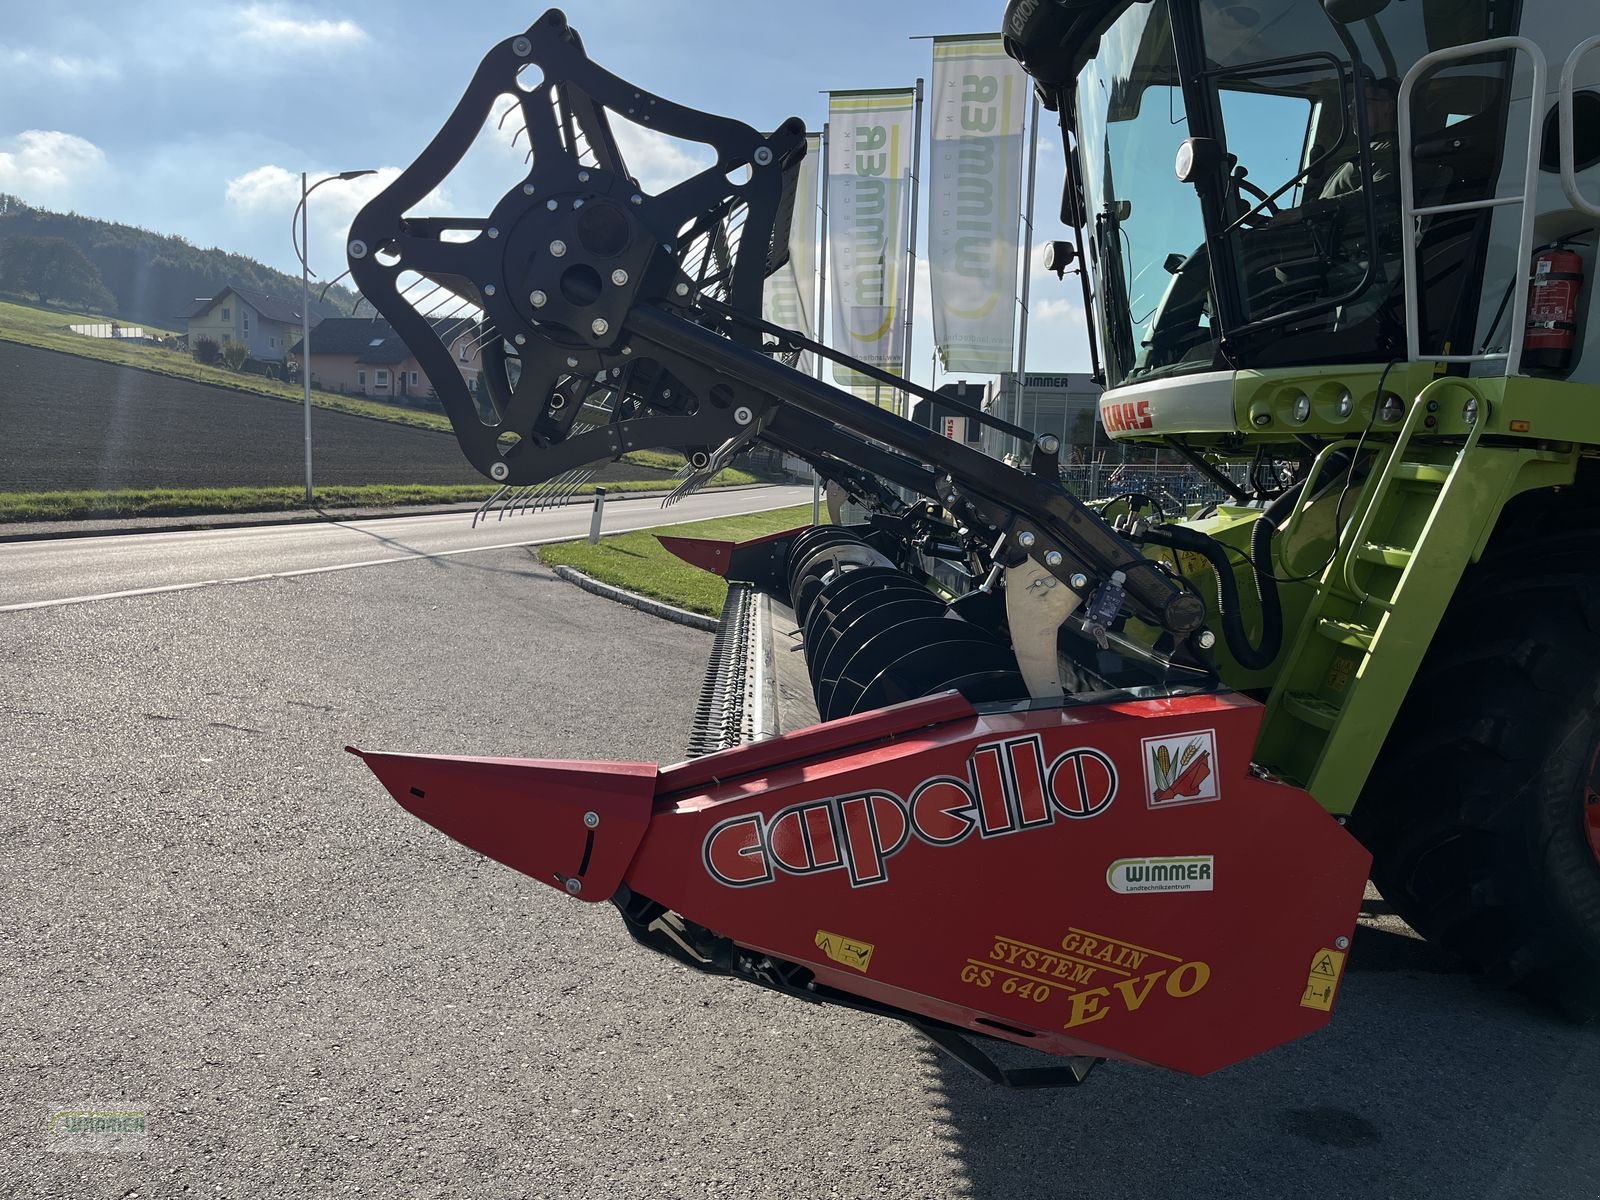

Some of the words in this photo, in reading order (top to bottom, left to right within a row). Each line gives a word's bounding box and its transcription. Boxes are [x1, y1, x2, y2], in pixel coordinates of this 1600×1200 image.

[1008, 0, 1040, 36] LEXION
[1103, 400, 1153, 432] CLAAS
[703, 733, 1118, 888] capello
[1125, 864, 1211, 882] WIMMER
[989, 942, 1097, 985] SYSTEM
[1061, 933, 1148, 970] GRAIN
[960, 964, 995, 988] GS
[1001, 977, 1050, 1003] 640
[1063, 961, 1211, 1029] EVO
